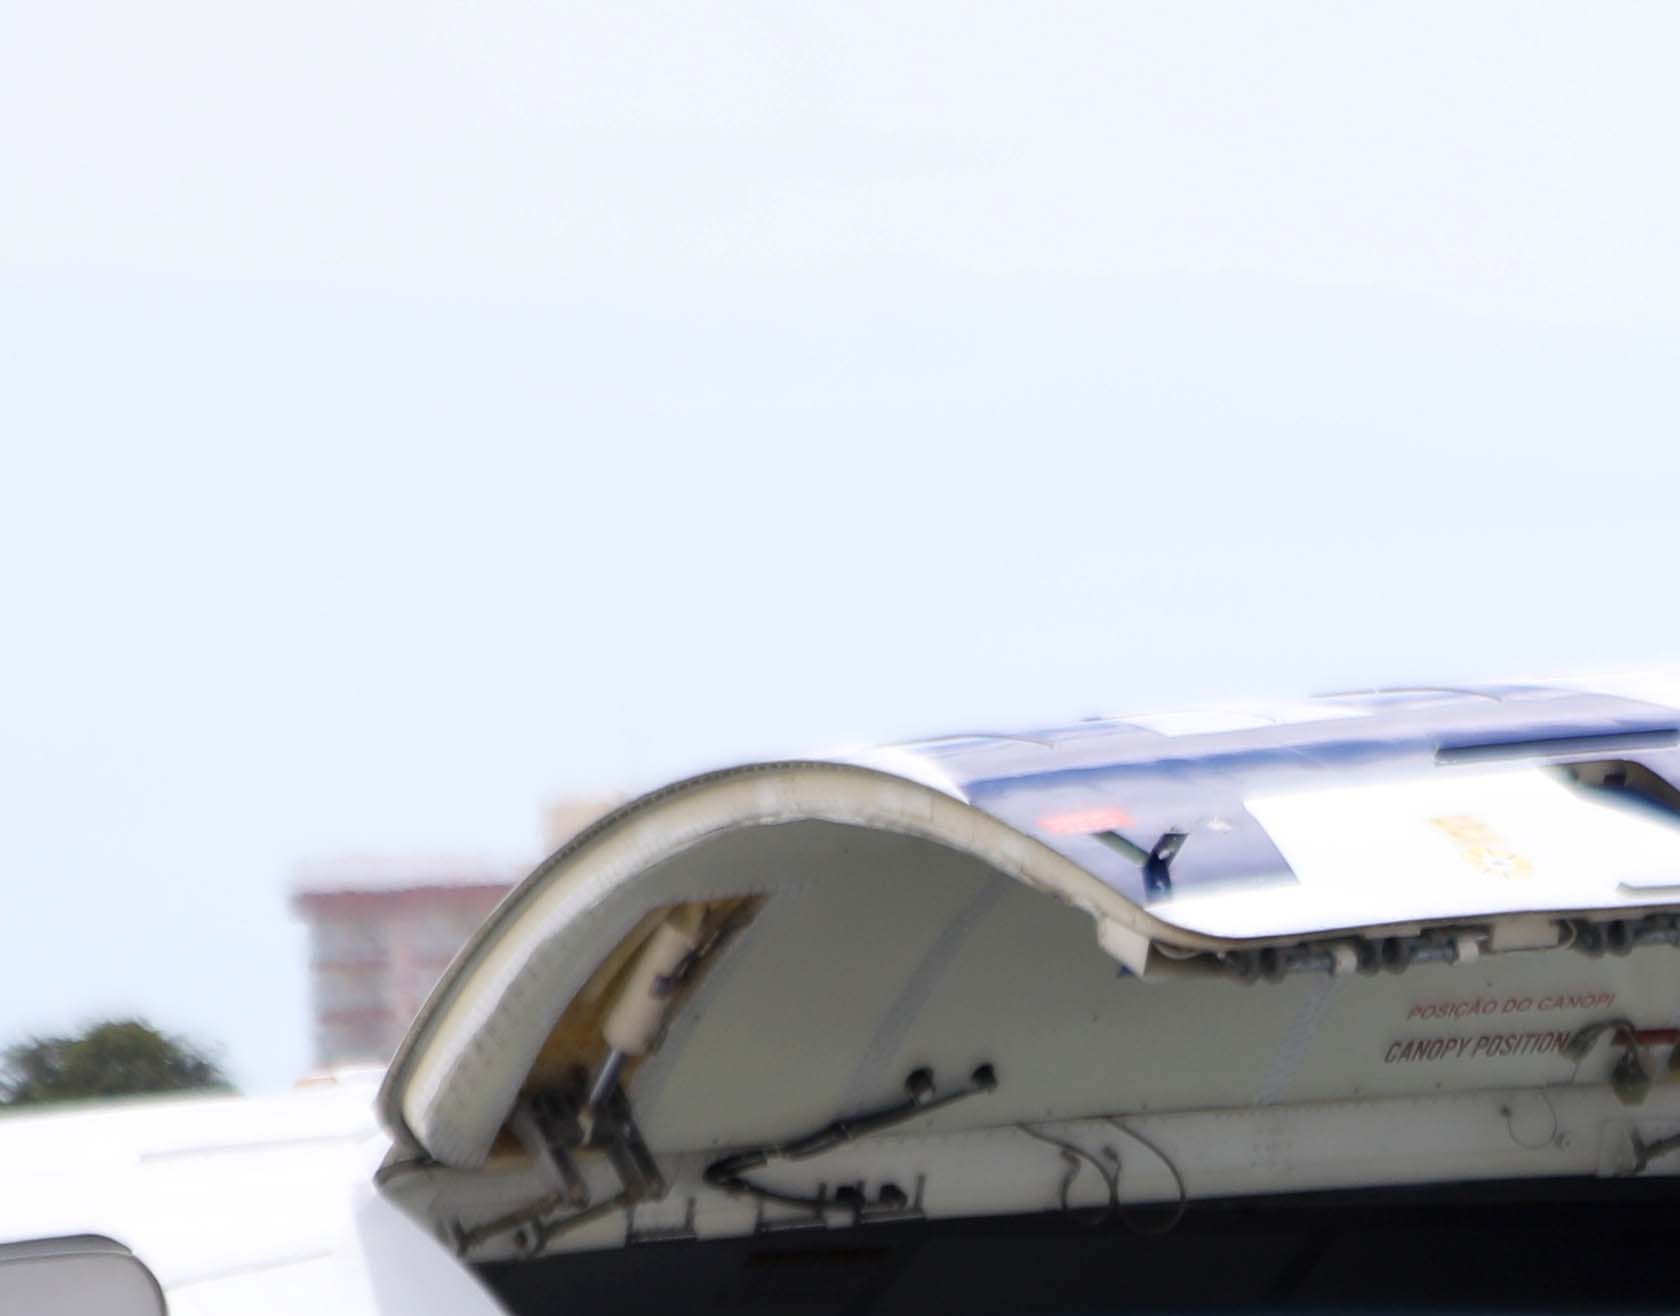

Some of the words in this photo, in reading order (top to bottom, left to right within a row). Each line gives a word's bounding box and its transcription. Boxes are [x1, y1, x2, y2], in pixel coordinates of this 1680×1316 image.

[1501, 997, 1533, 1014] DO
[1383, 1036, 1472, 1064] CANOPY
[1471, 1031, 1572, 1058] POSITION
